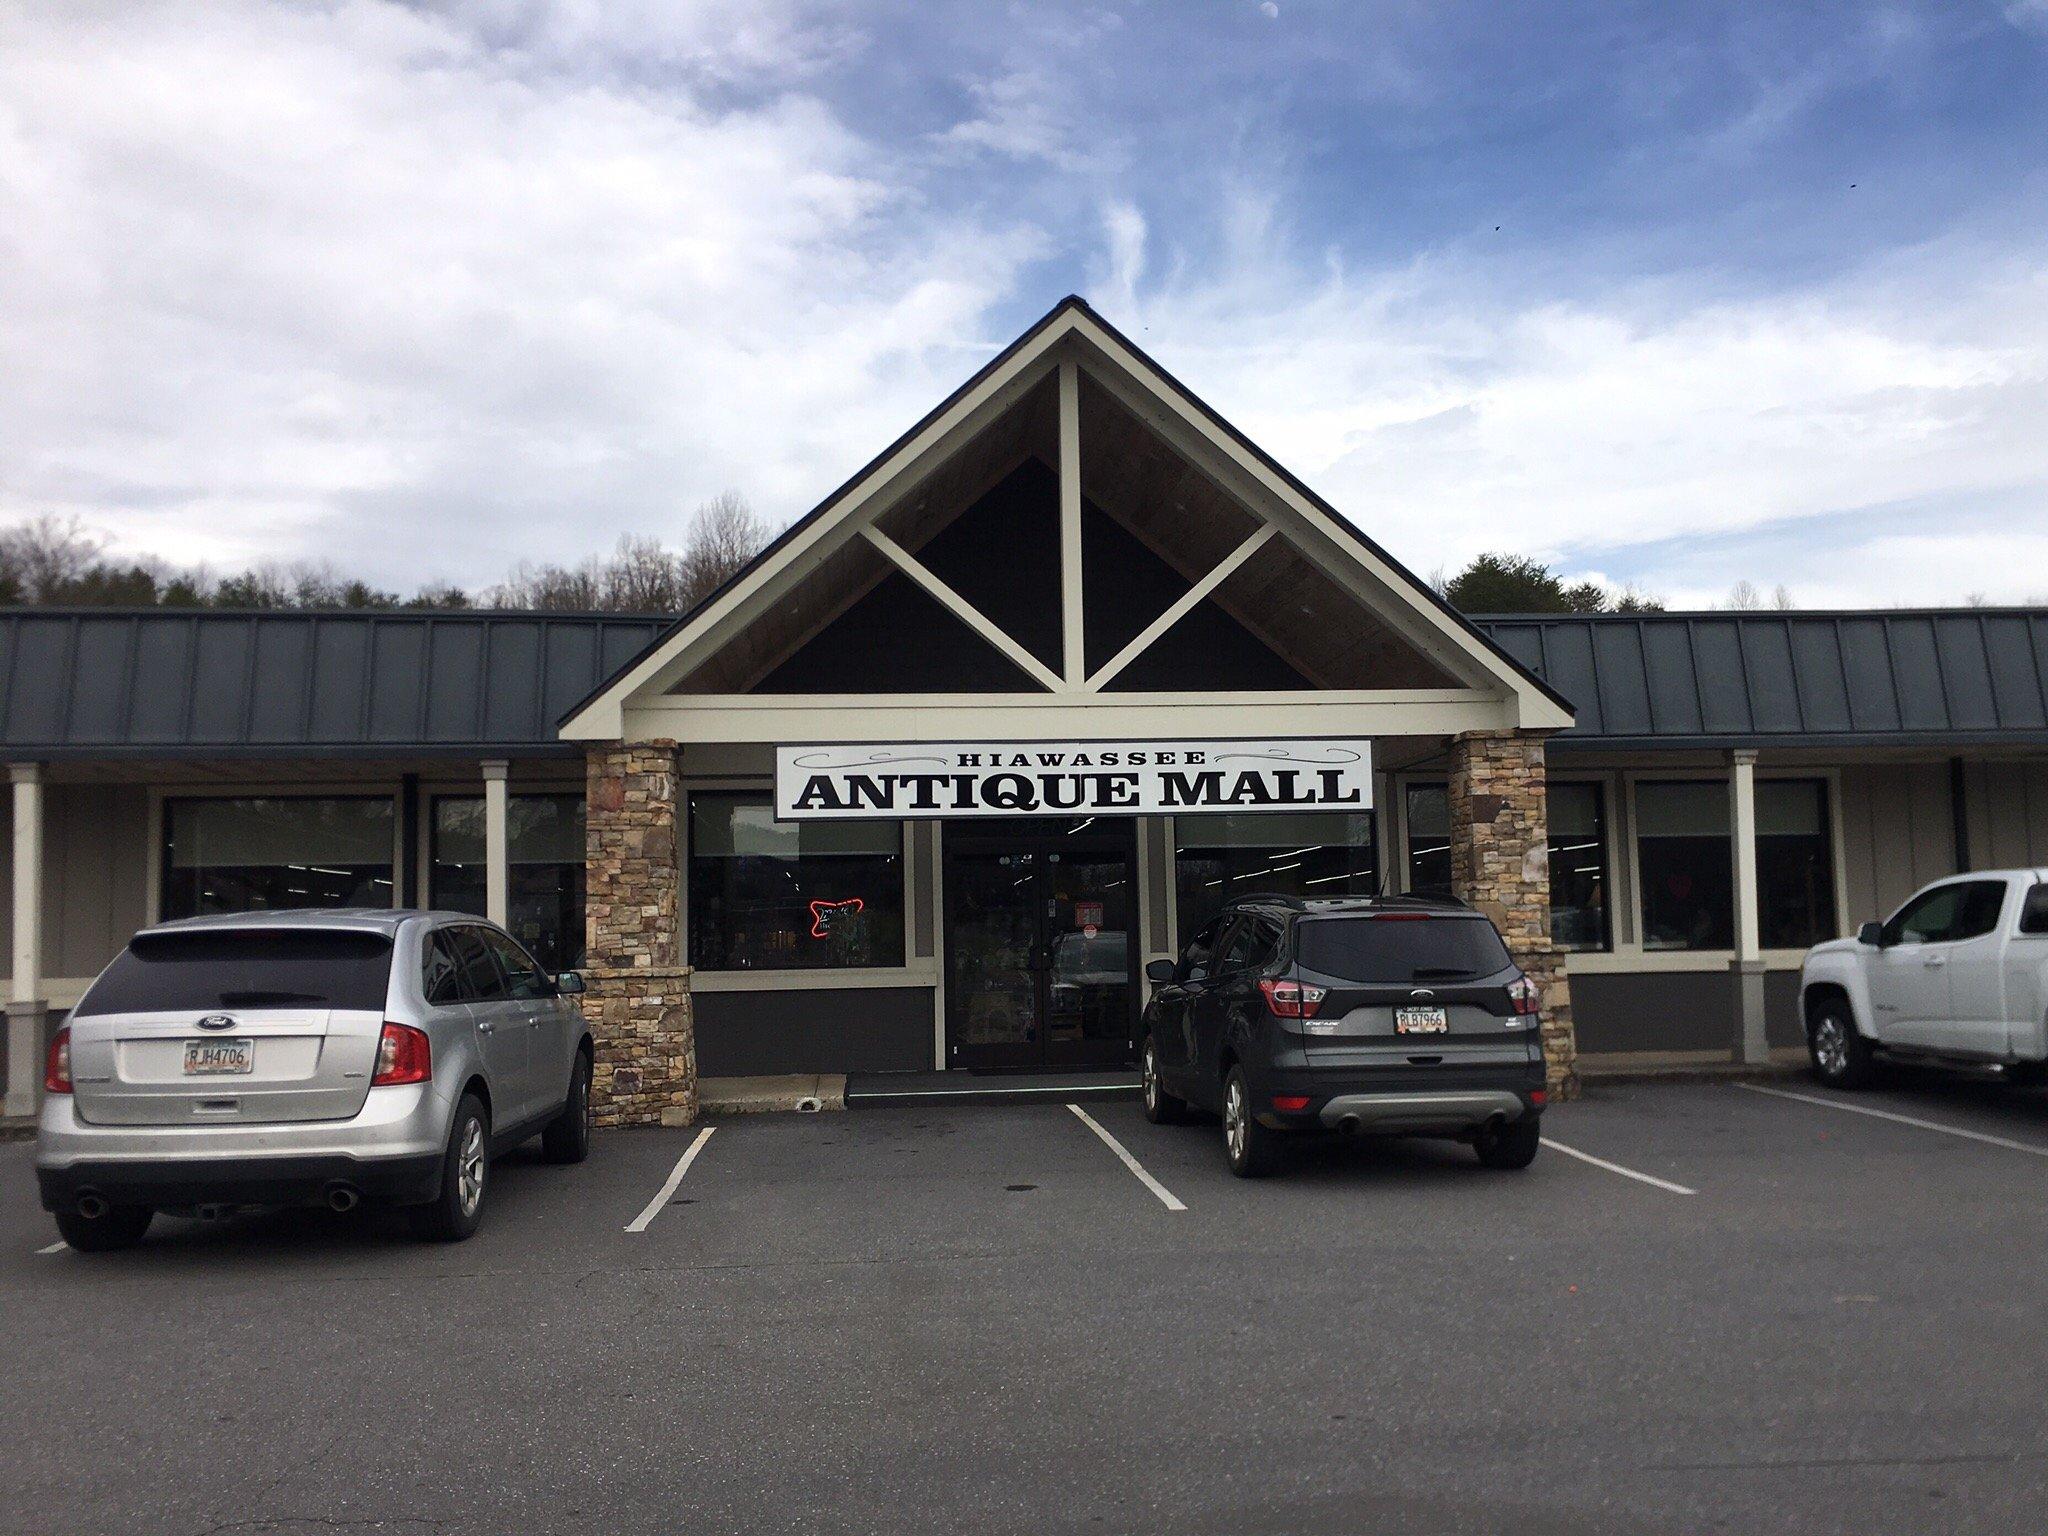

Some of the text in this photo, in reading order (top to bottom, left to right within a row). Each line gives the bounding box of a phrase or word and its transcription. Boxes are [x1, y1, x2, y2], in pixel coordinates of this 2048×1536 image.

[956, 751, 1206, 767] HIAWASSEE
[791, 769, 1361, 811] ANTIQUE MALL
[189, 1048, 245, 1066] RJH4706
